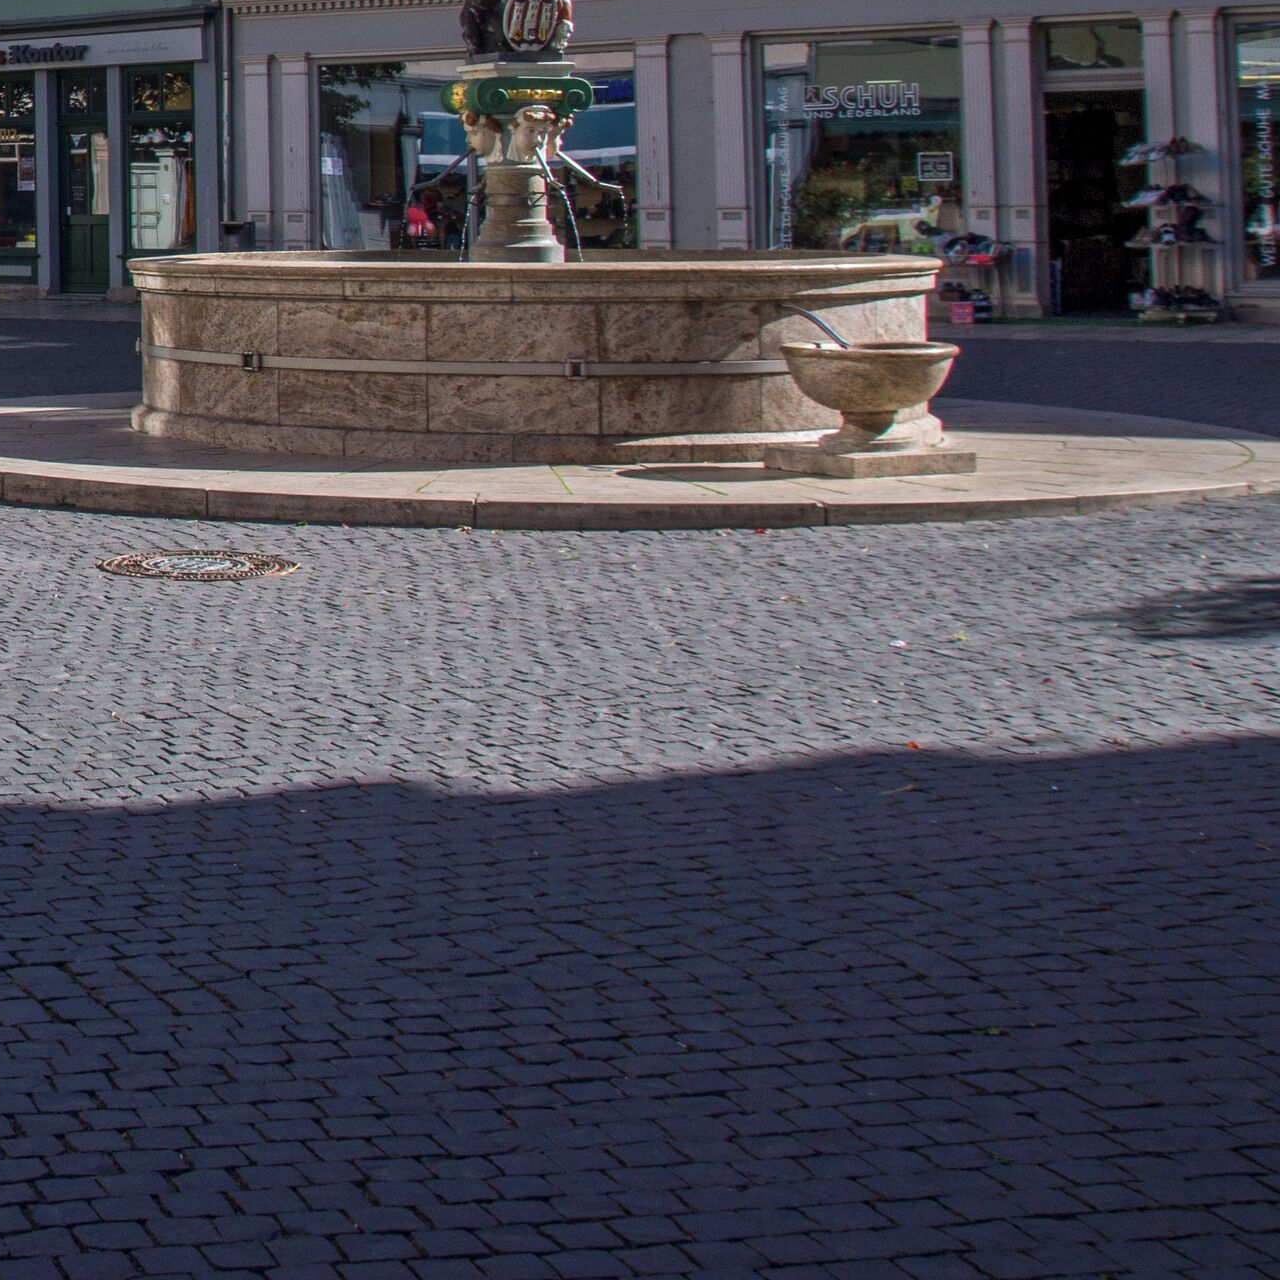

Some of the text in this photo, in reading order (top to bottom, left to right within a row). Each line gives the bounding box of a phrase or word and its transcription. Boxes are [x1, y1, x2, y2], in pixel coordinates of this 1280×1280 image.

[14, 42, 88, 64] Kontor
[803, 83, 919, 111] SCHUH
[1256, 78, 1272, 100] MA
[804, 108, 920, 119] UND LEDERLAND
[1256, 108, 1273, 161] SCHUHE
[781, 230, 793, 250] EIL
